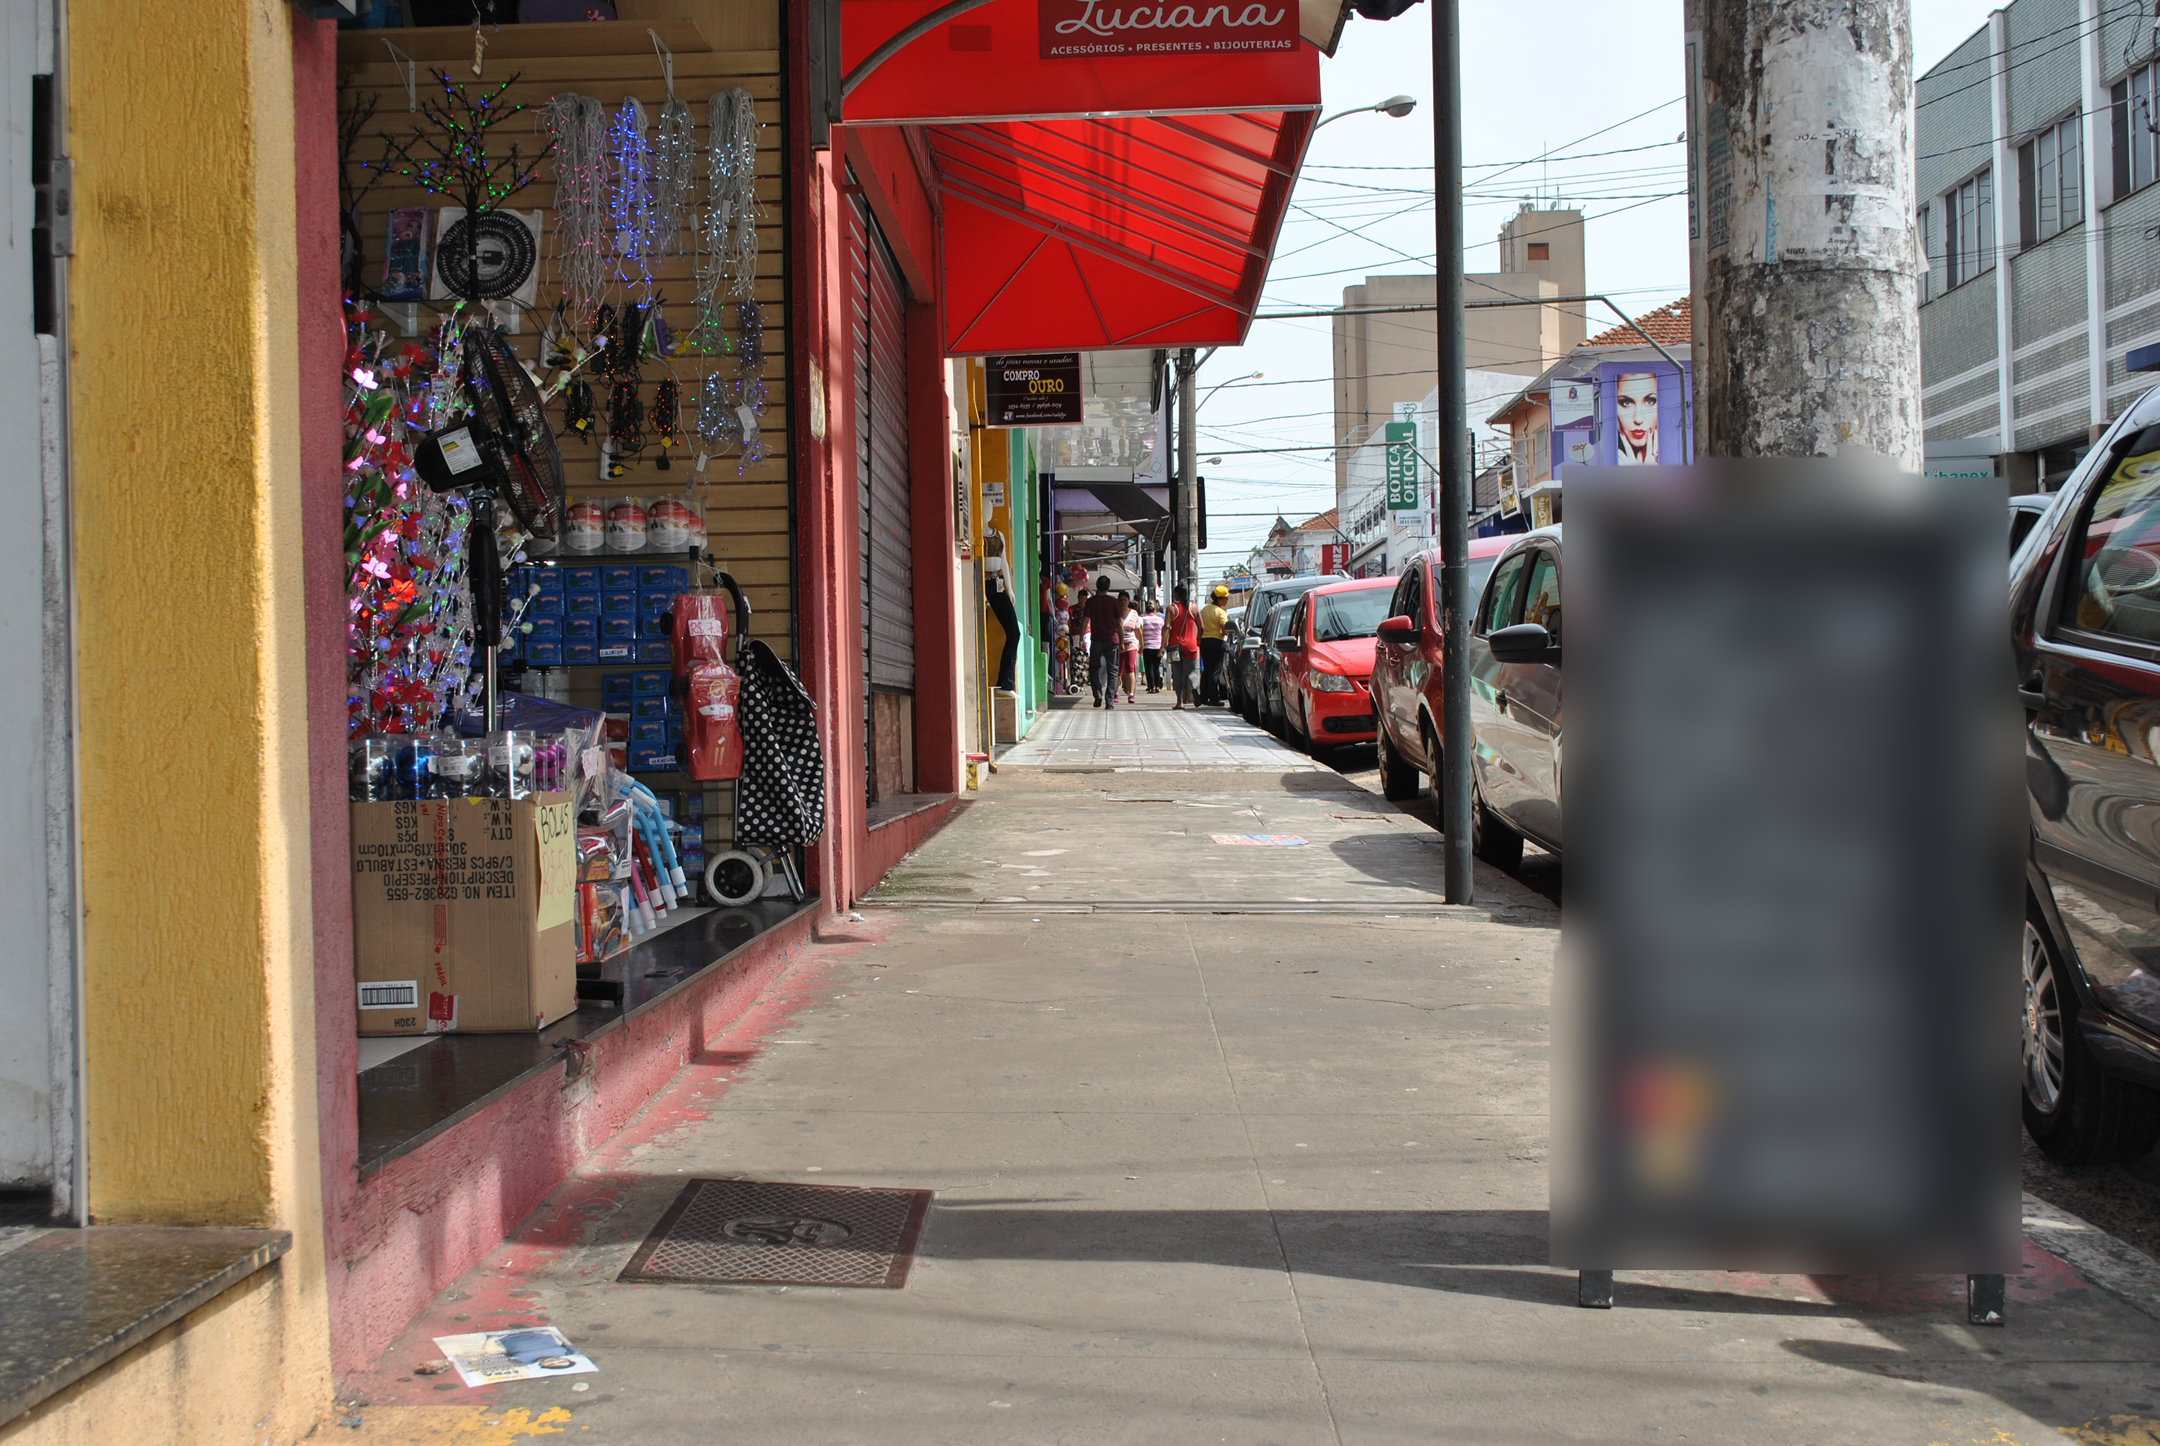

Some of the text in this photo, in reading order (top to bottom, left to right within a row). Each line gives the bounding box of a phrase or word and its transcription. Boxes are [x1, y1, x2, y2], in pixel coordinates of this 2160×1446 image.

[1055, 0, 1285, 36] Luciana
[1051, 40, 1292, 55] ACESSÓRIOS PRESENTES BIJOUTERIAS
[1003, 370, 1040, 381] COMPRO
[1029, 378, 1064, 394] OURO
[1402, 430, 1415, 503] OFICINAL
[1389, 445, 1401, 503] BOTICA
[394, 801, 417, 814] KGS
[396, 816, 418, 828] KGS
[436, 803, 446, 827] Nipo
[540, 804, 569, 845] BOLAS
[470, 856, 512, 868] C/9PCS
[384, 874, 438, 886] PRESEPIO
[462, 886, 480, 899] NO:
[487, 885, 515, 898] ITEM
[434, 962, 448, 988] FRÁGIL
[394, 1017, 416, 1028] 230H
